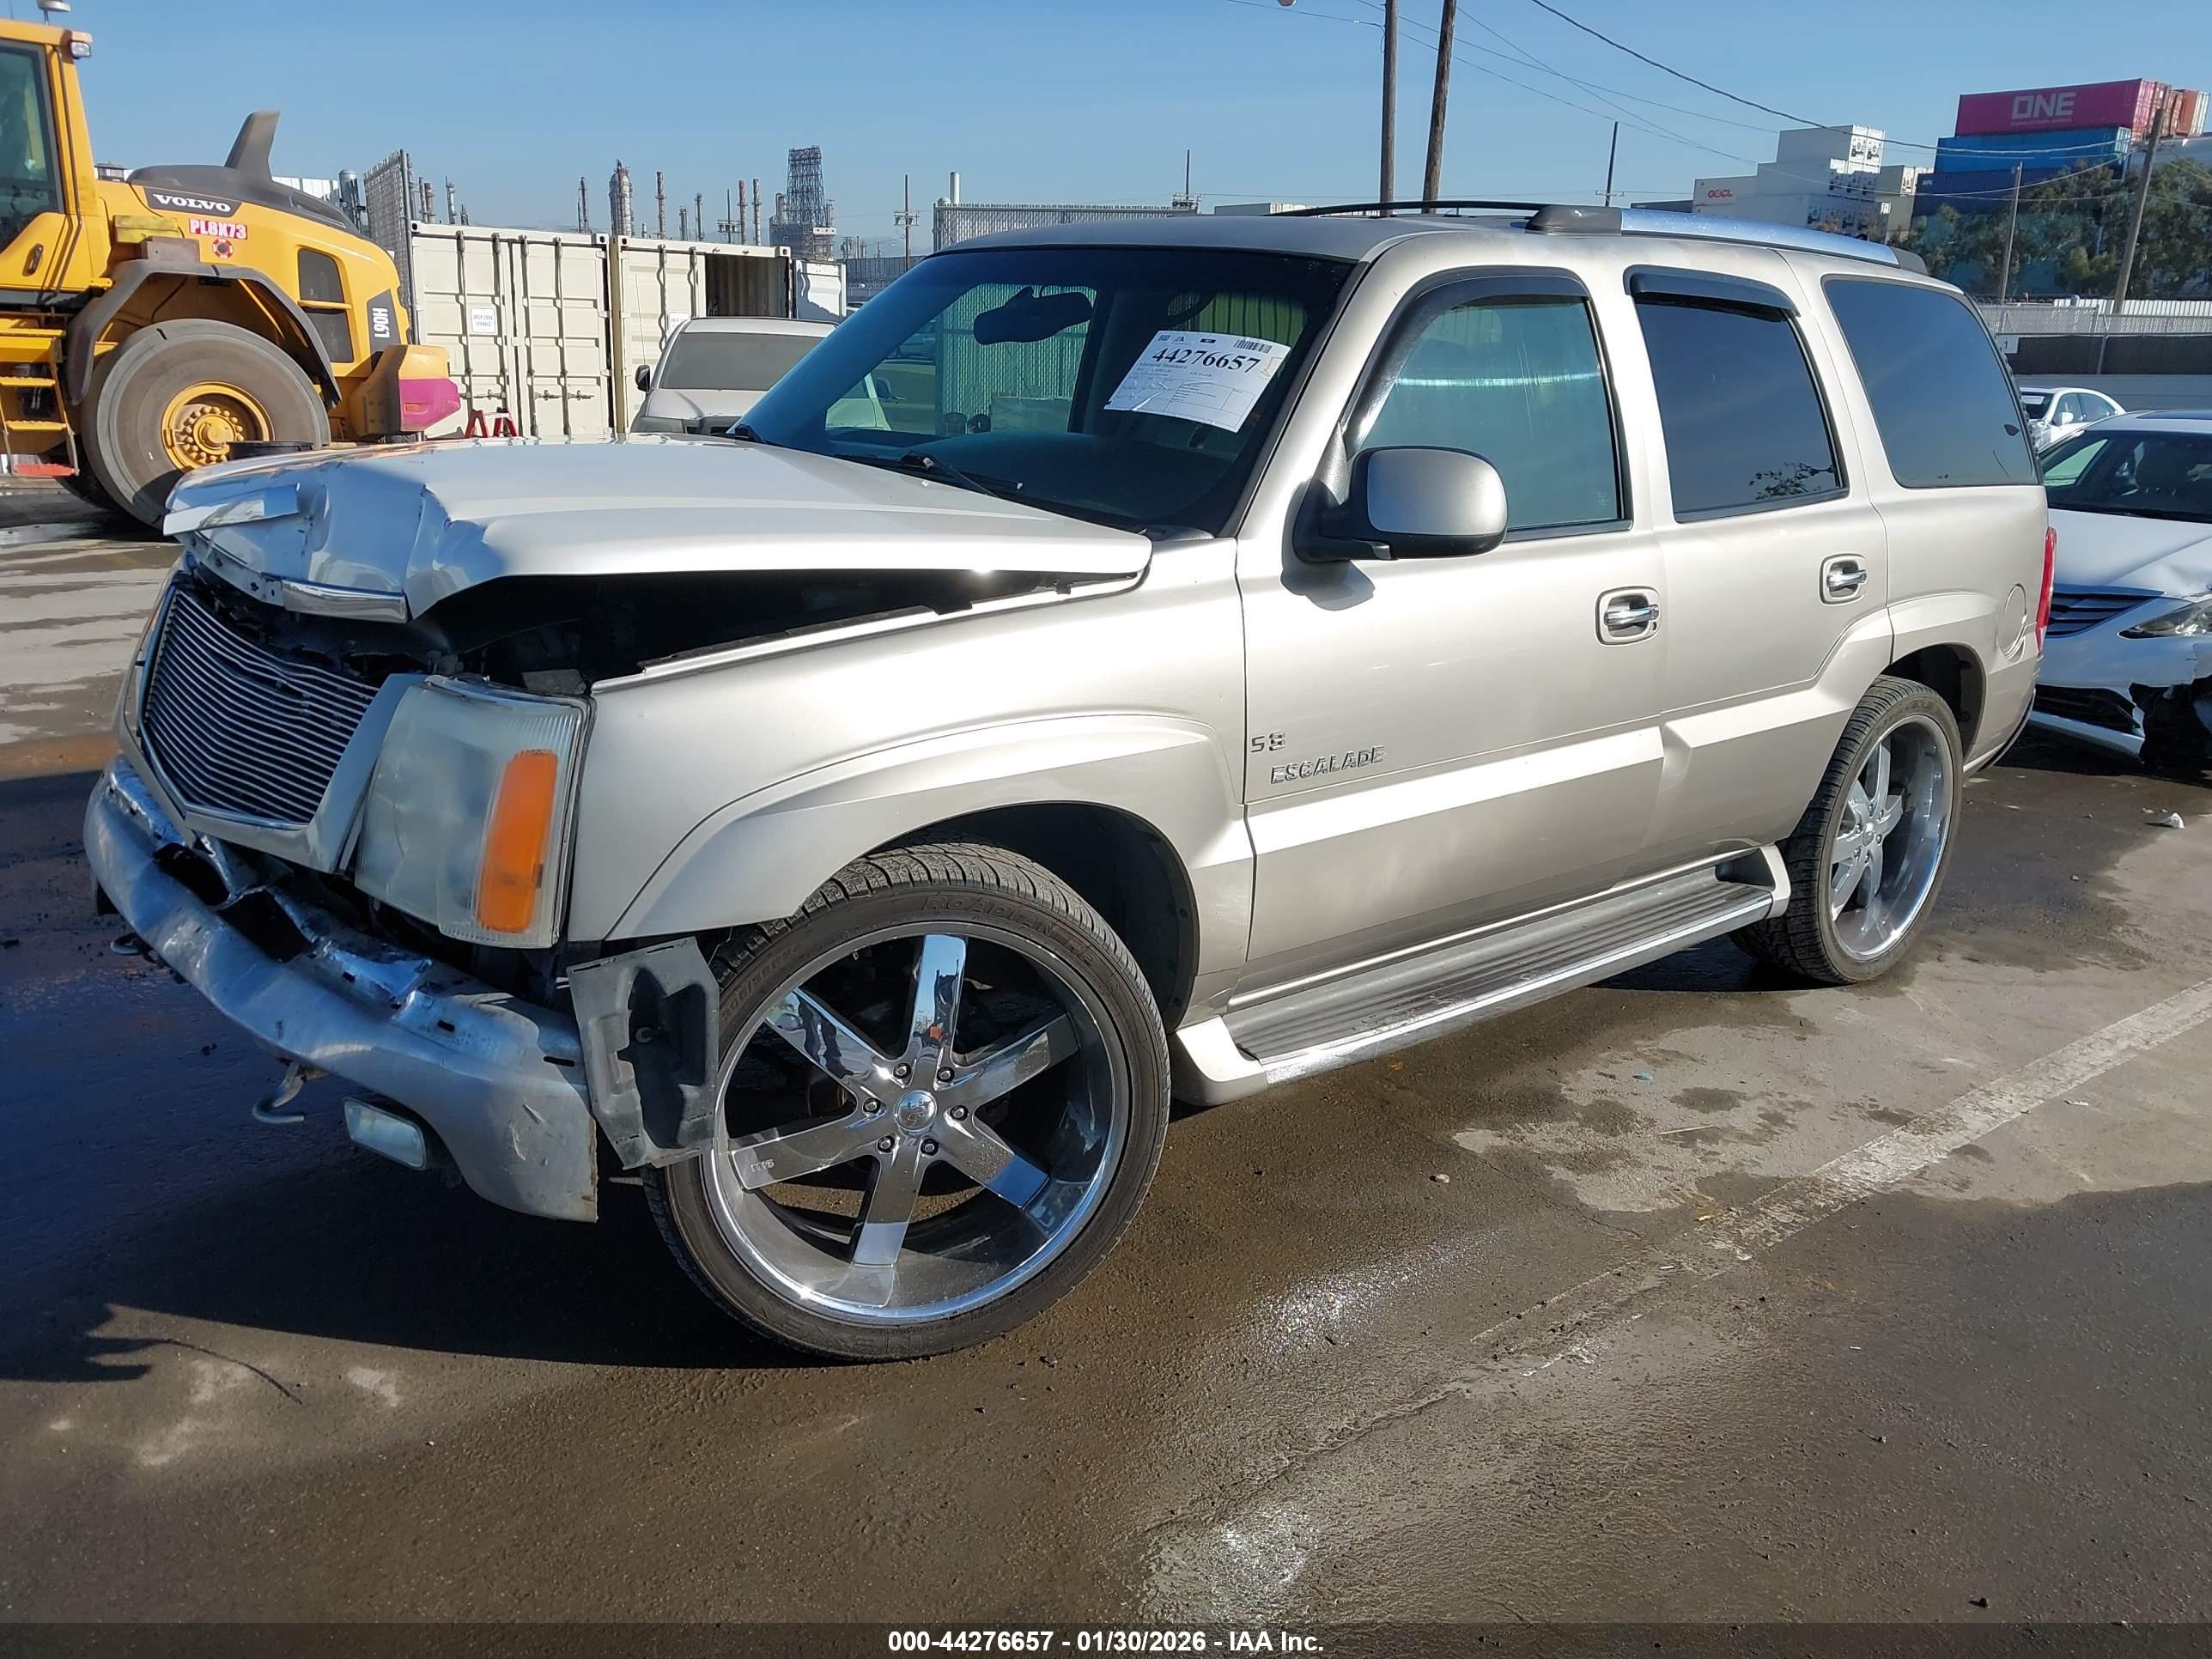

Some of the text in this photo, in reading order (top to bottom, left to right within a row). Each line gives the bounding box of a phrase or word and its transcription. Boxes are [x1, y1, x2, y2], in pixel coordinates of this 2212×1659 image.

[2012, 92, 2076, 119] ONE
[153, 194, 231, 212] VOLVO
[190, 219, 246, 239] PL8X73
[372, 307, 390, 338] L90H
[1152, 347, 1261, 374] 44276657
[1271, 744, 1386, 785] ESCALADE
